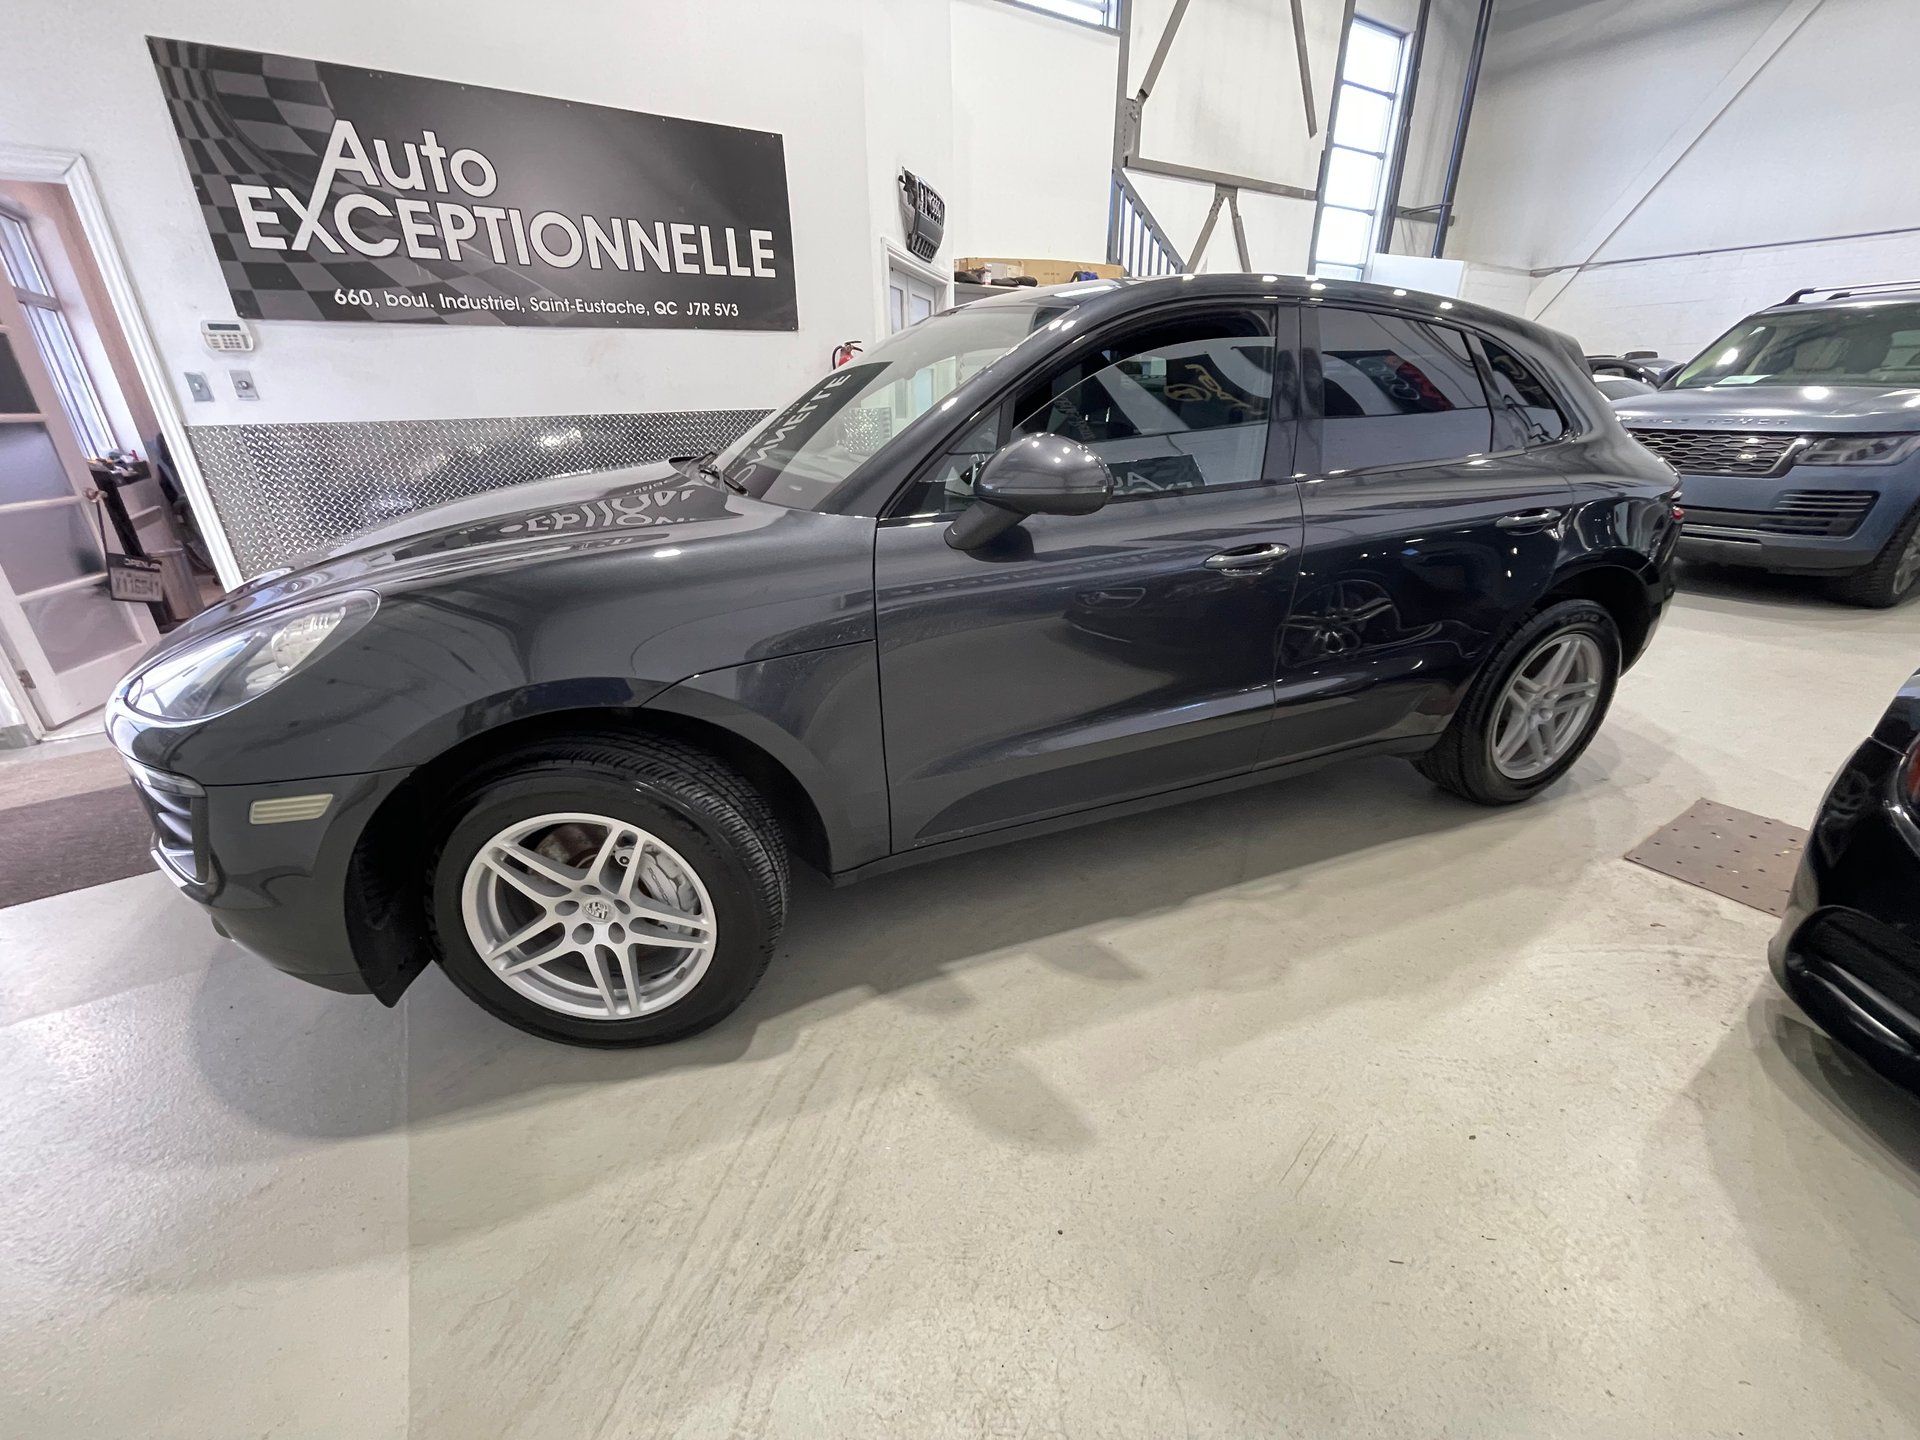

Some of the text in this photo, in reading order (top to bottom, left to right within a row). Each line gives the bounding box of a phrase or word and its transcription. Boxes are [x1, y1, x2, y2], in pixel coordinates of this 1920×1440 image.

[311, 119, 498, 197] Auto
[231, 184, 776, 278] EXCEPTIONNELLE
[334, 288, 739, 318] 660, boul. Industriel, Saint-Eustache, QC J7R 5V3
